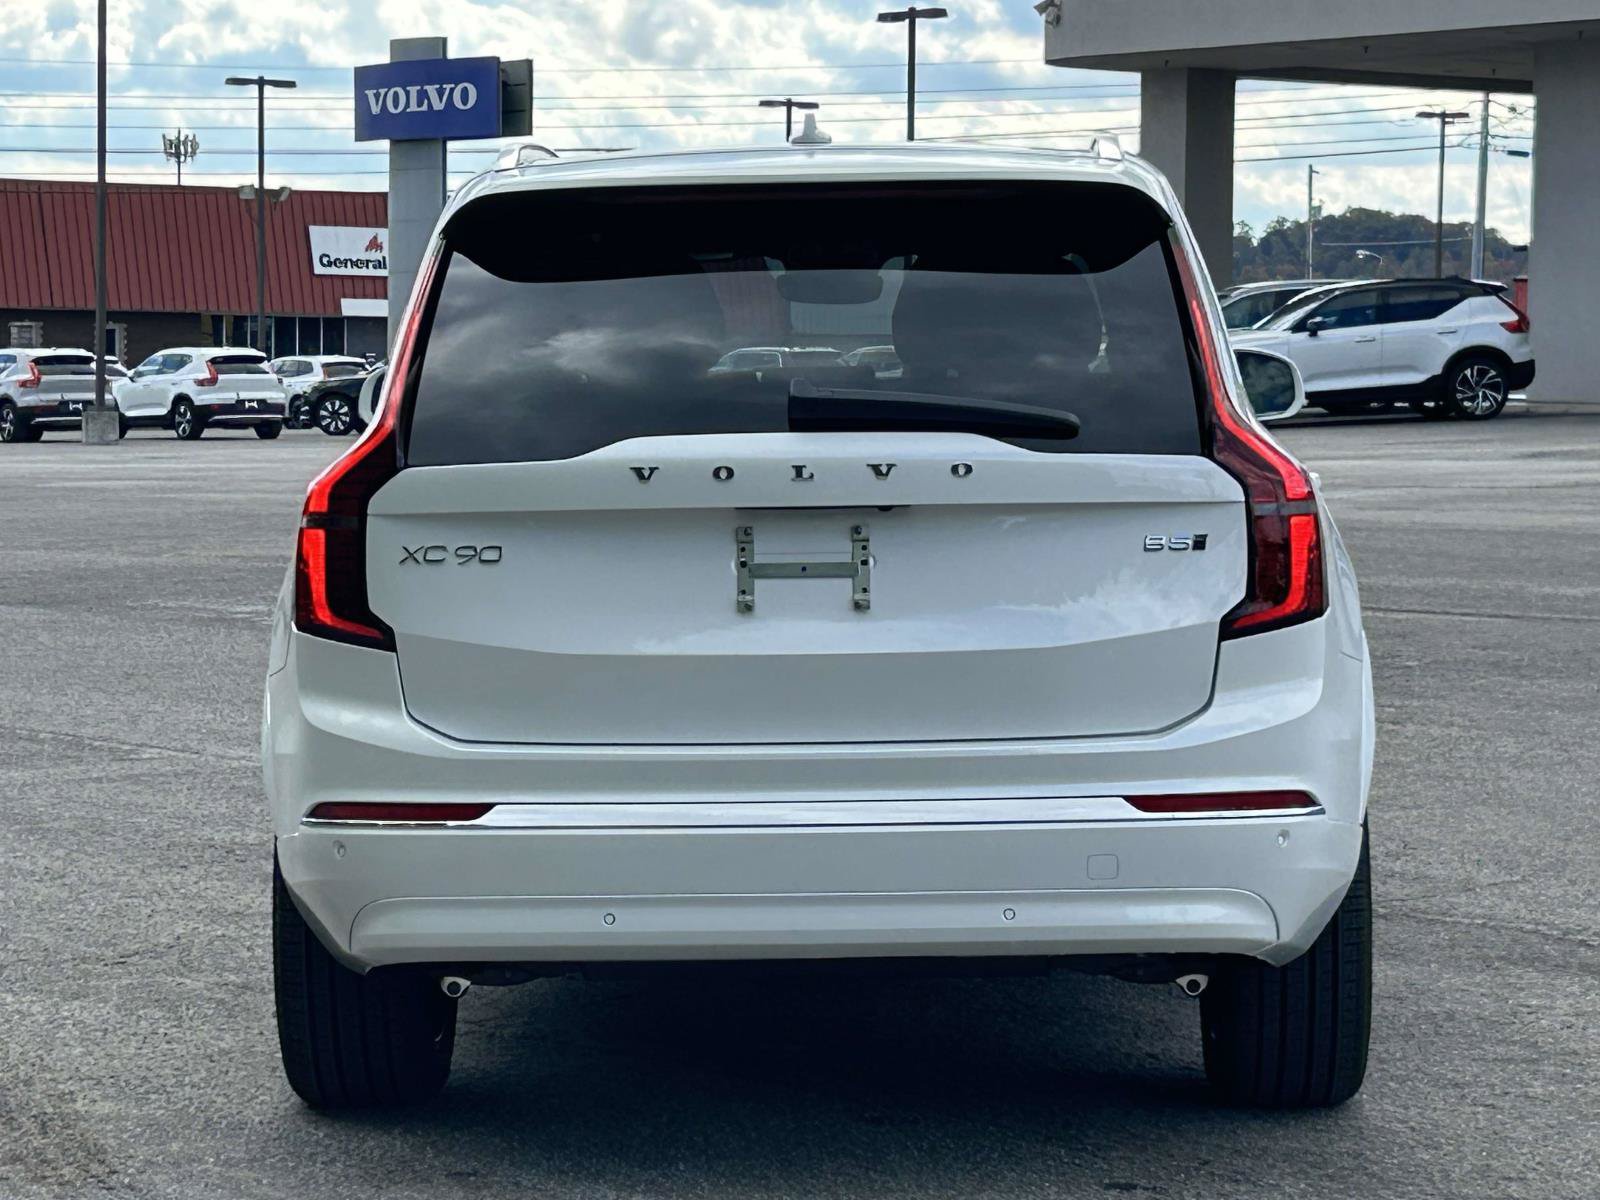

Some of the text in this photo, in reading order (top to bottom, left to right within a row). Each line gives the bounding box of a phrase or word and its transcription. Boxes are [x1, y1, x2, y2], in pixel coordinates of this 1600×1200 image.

[365, 82, 477, 115] VOLVO
[319, 253, 387, 270] General
[629, 463, 974, 484] VOLVO
